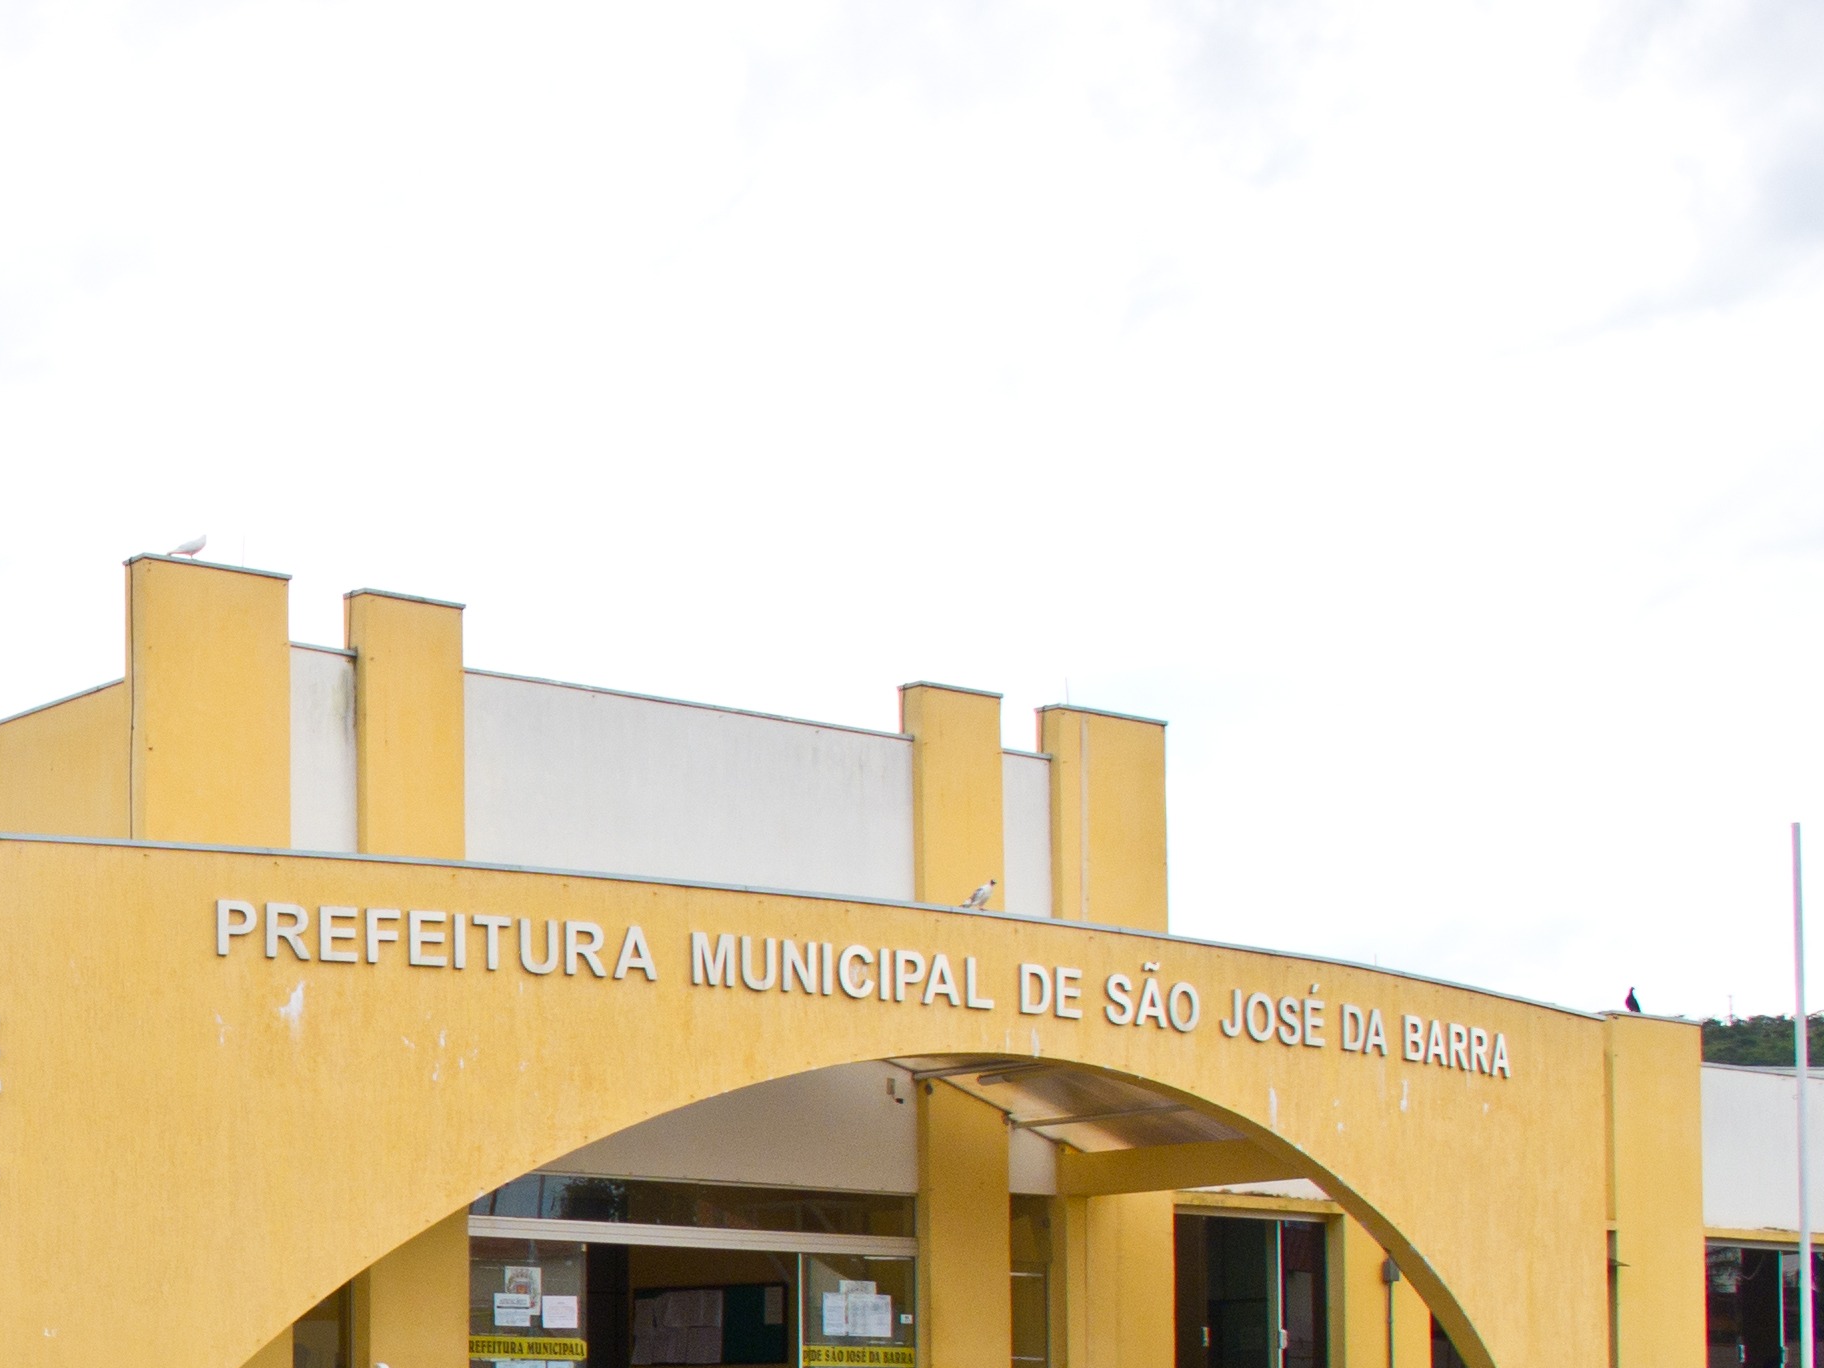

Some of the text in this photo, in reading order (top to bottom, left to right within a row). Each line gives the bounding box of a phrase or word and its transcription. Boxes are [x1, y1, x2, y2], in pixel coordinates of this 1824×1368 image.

[216, 899, 1511, 1080] PREFEITURA MUNICIPAL DE SÃO JOSÉ DA BARRA
